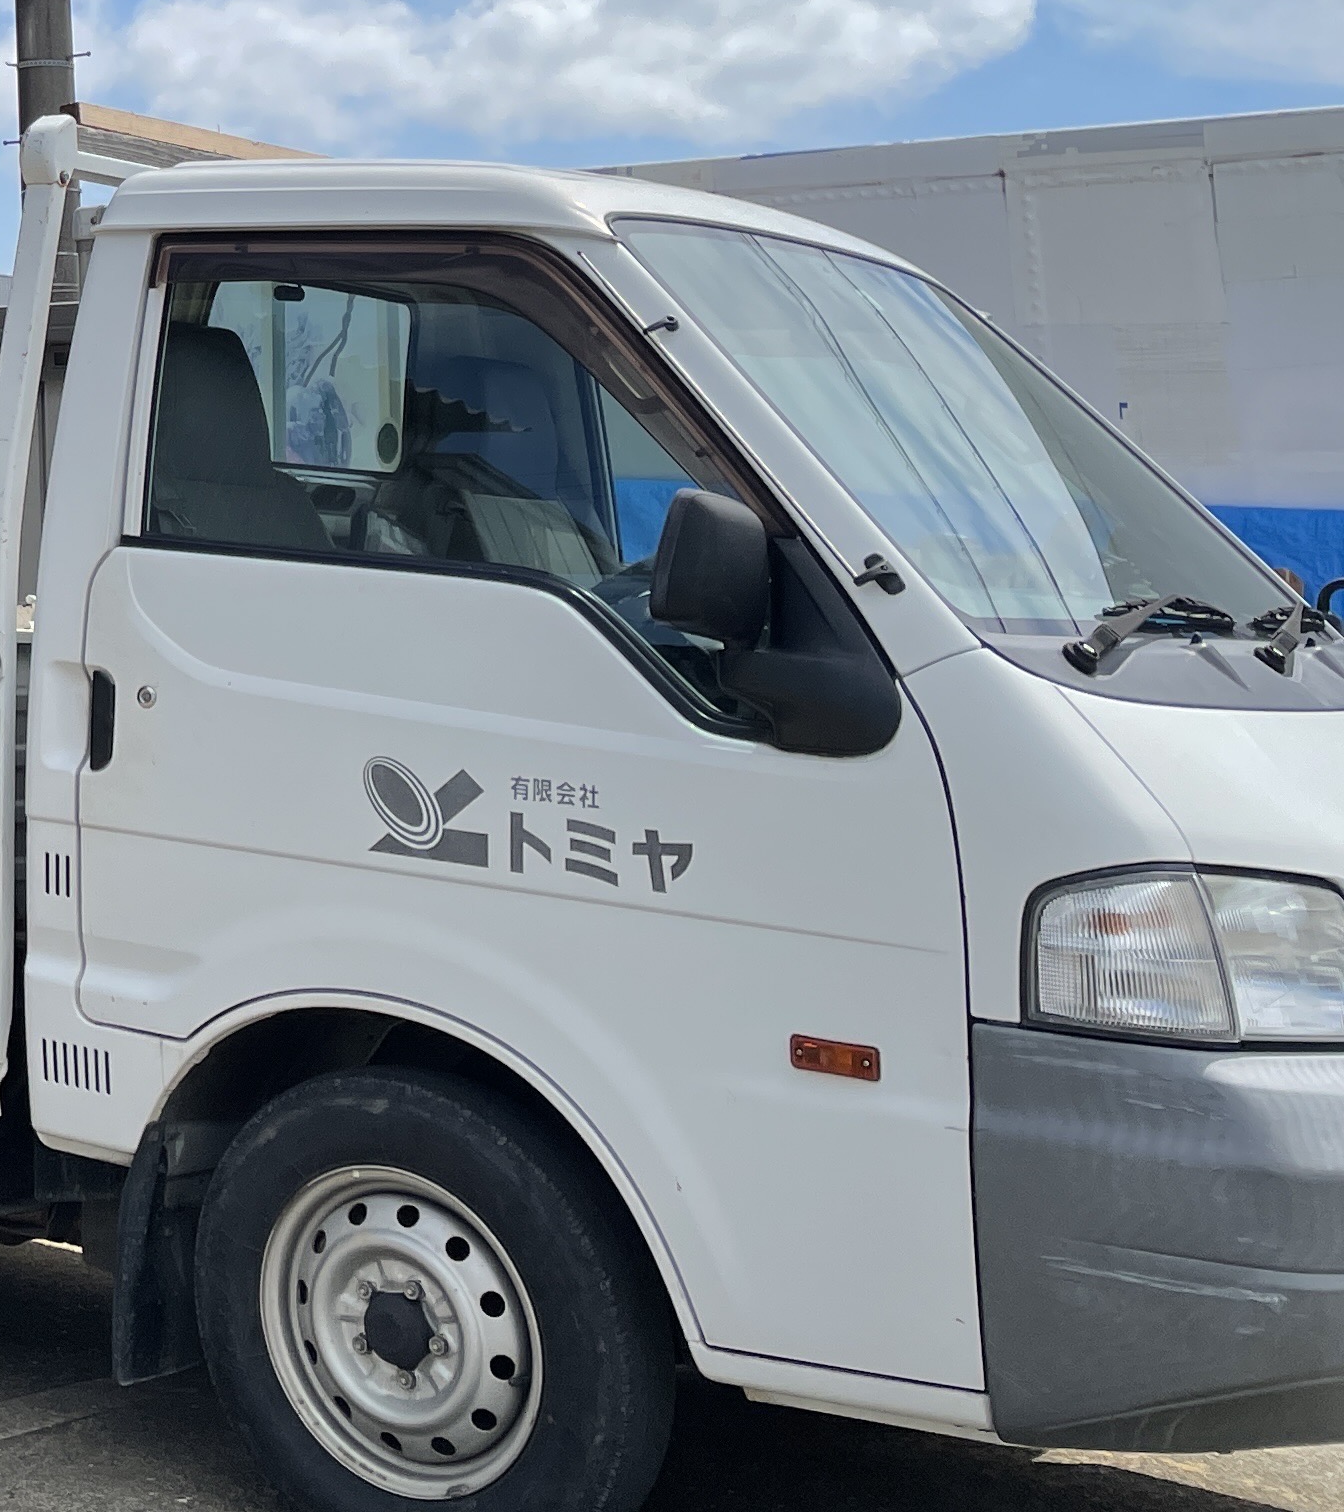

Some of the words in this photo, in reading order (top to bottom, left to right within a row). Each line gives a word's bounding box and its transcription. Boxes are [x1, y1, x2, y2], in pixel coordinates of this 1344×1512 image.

[510, 775, 600, 809] 有限会社
[510, 811, 693, 893] トミヤ
